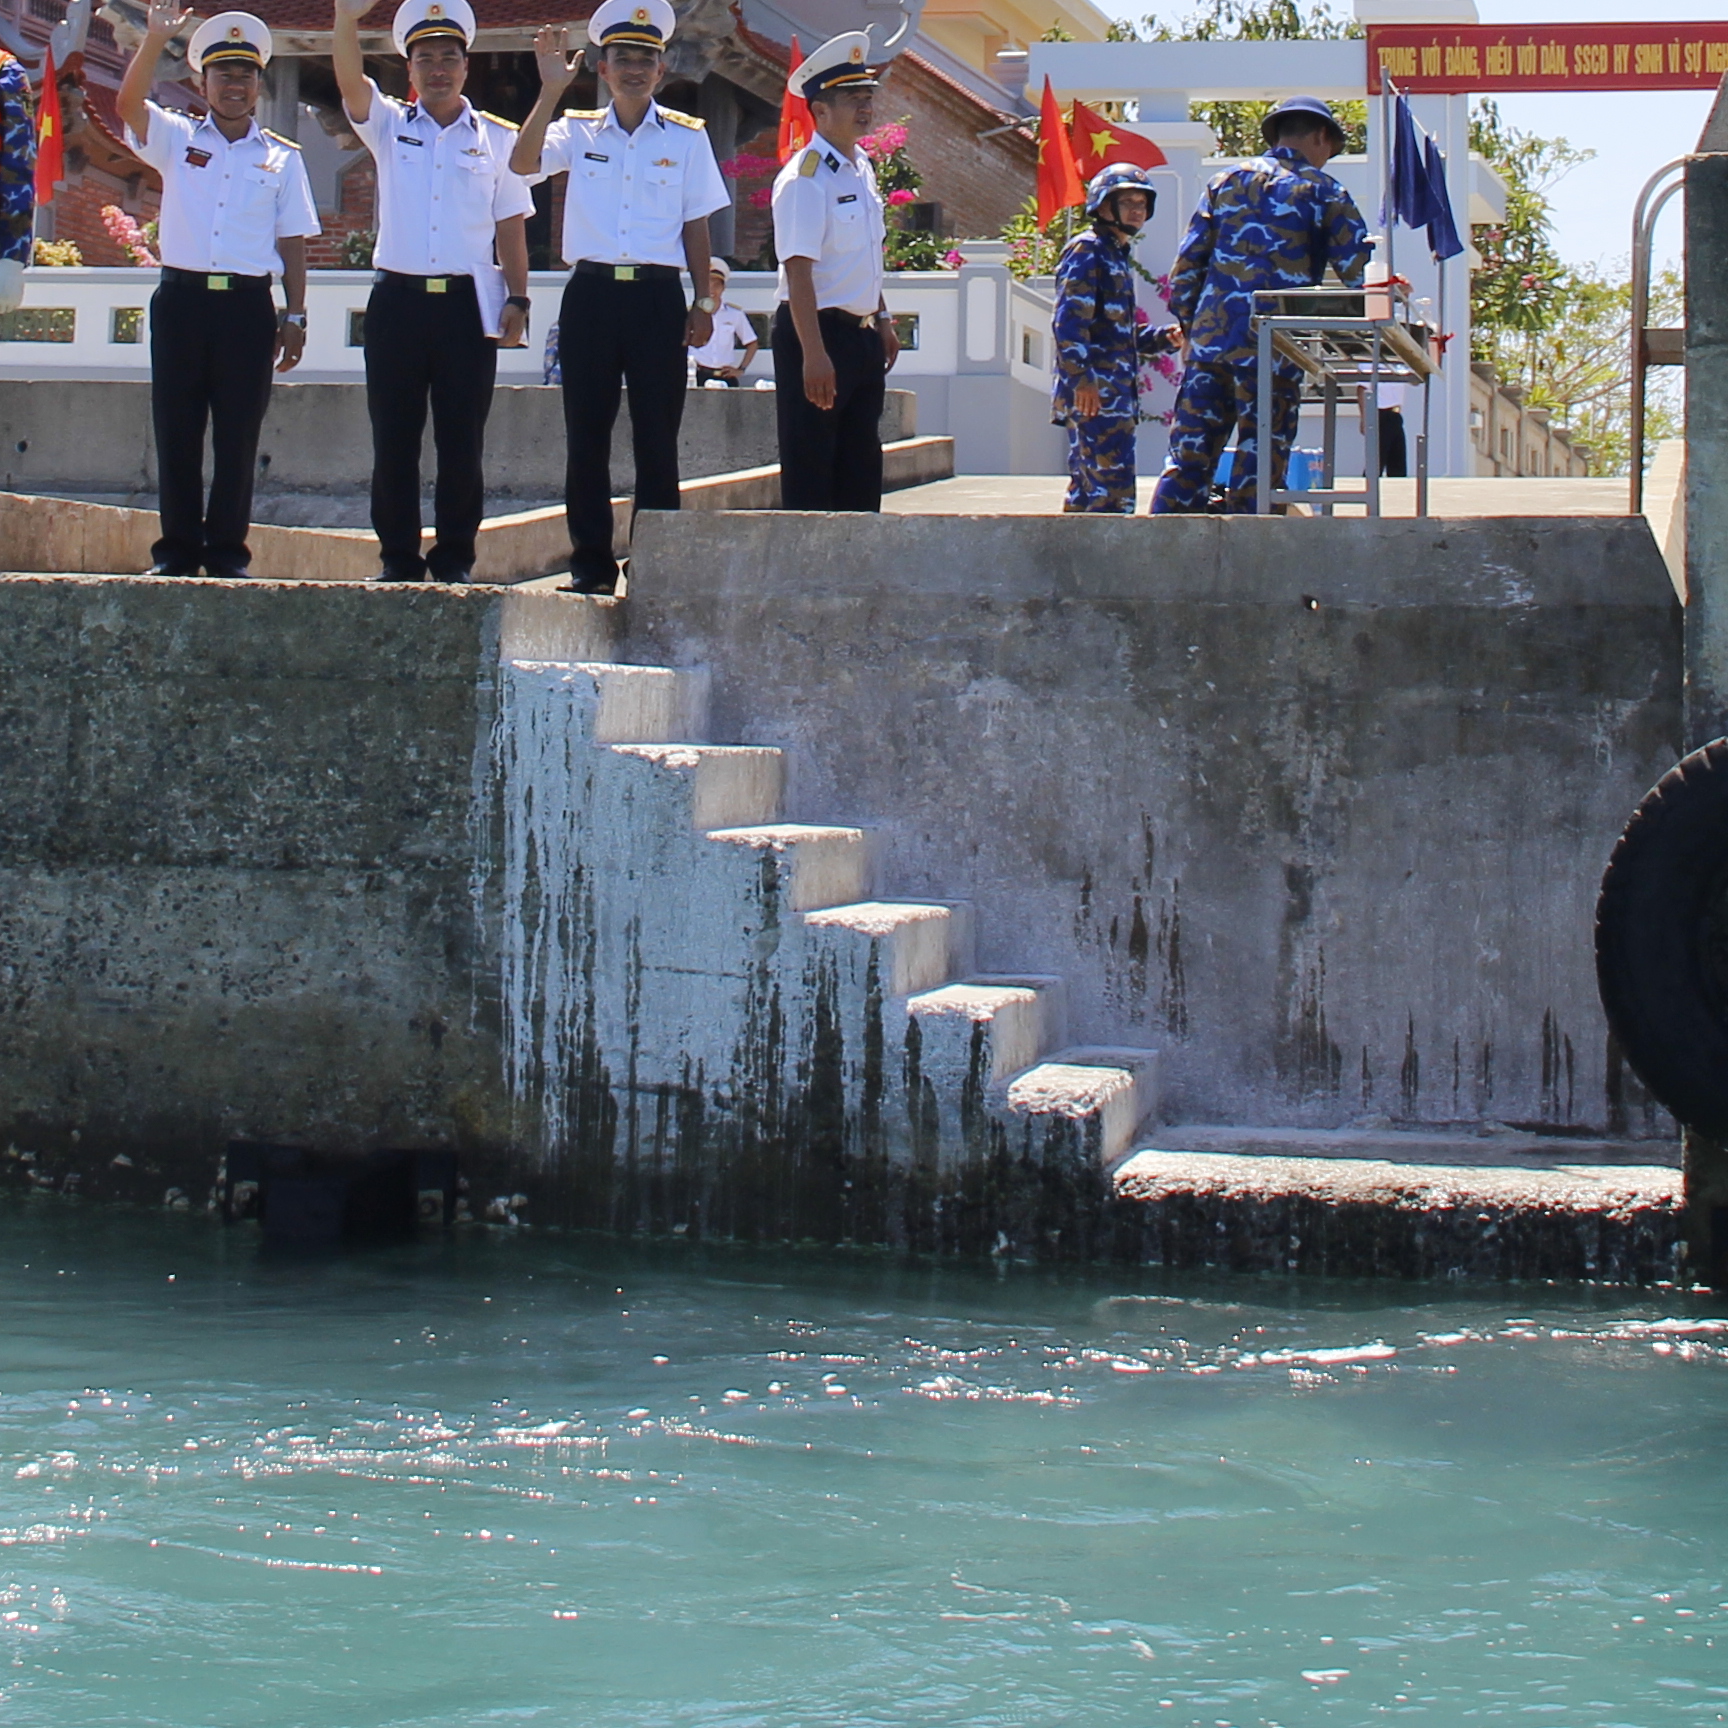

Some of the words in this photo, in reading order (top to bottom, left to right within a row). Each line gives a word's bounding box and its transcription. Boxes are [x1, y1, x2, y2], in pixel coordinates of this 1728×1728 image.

[1377, 46, 1417, 76] TRUNG
[1421, 37, 1441, 76] VỚI
[1445, 35, 1481, 79] ĐẢNG,
[1485, 35, 1512, 76] HIẾU
[1516, 36, 1537, 76] VỚI
[1540, 38, 1569, 79] DÂN,
[1574, 44, 1608, 75] SSCĐ
[1613, 43, 1630, 74] HY
[1634, 43, 1663, 74] SINH
[1667, 36, 1680, 74] VÌ
[1684, 39, 1703, 79] SỰ
